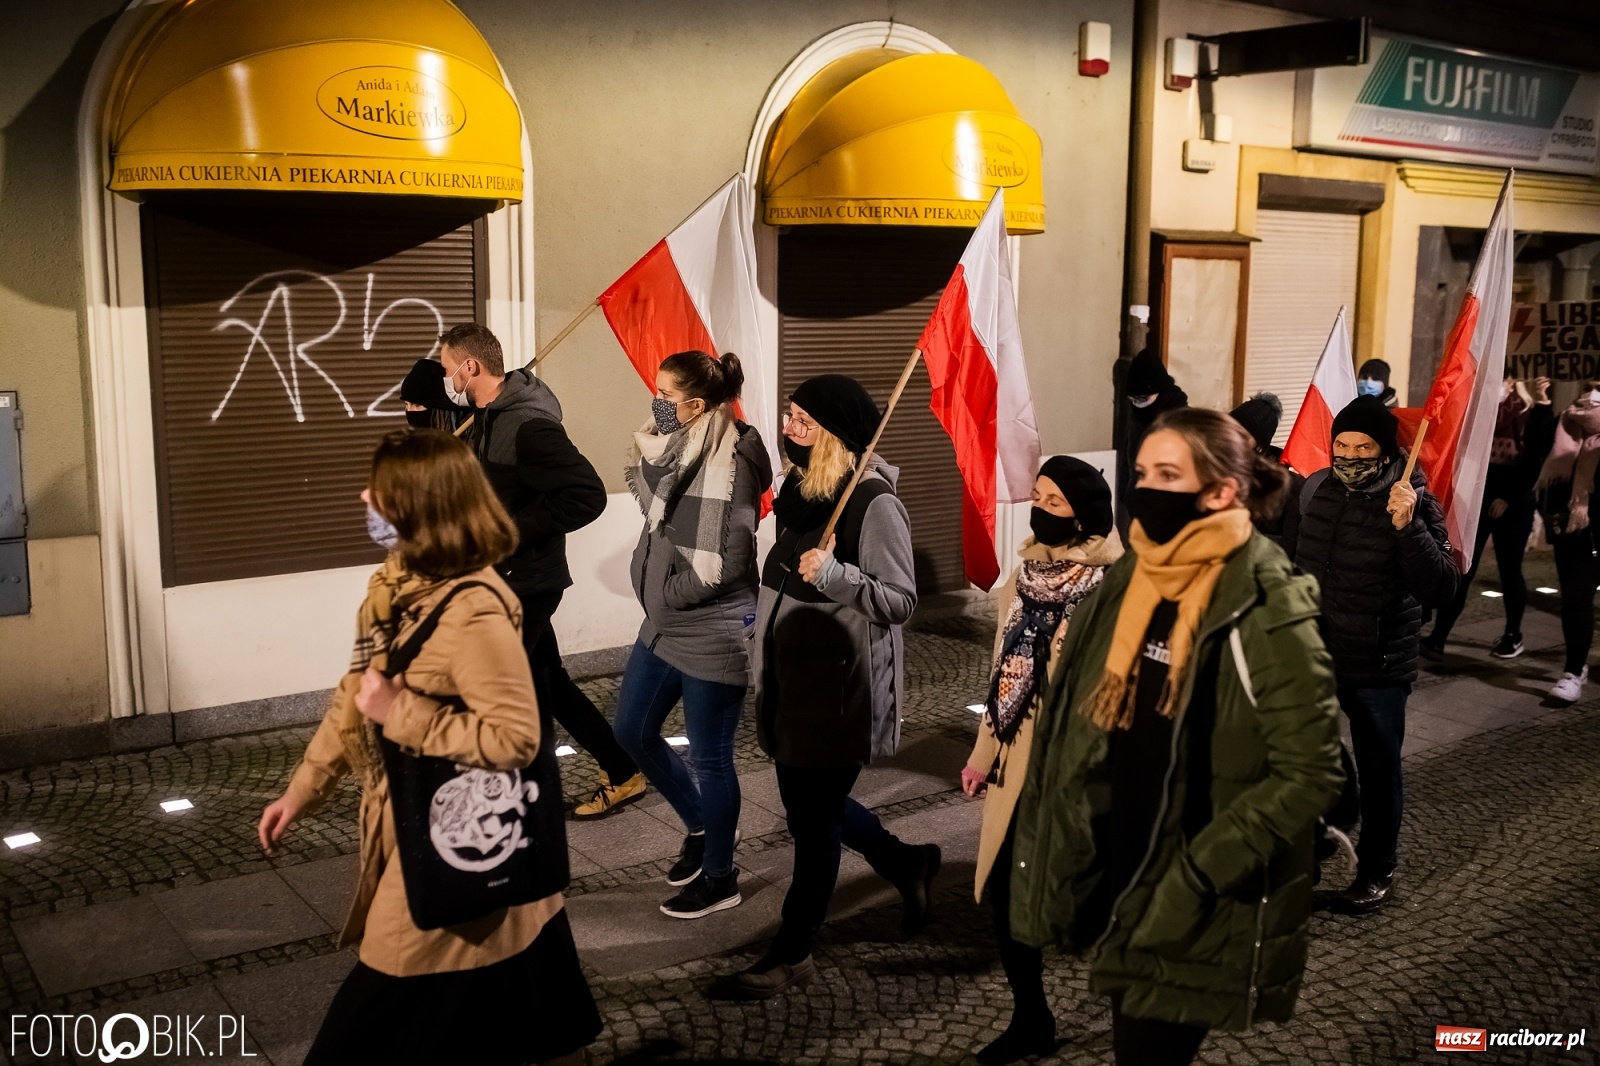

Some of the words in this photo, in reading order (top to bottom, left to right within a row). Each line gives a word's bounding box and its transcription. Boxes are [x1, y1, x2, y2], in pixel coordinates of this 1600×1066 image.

[356, 78, 392, 91] Anida
[395, 80, 400, 91] i
[1404, 56, 1541, 118] FUJIFILM
[336, 96, 455, 127] Markiewka
[117, 166, 175, 183] PIEKARNIA
[179, 165, 282, 182] CUKIERNIA
[289, 167, 396, 185] PIEKARNIA
[400, 170, 483, 189] CUKIERNIA
[769, 206, 832, 218] PIEKARNIA
[836, 206, 919, 219] CUKIERNIA
[923, 207, 985, 221] PIEKARN
[1005, 210, 1039, 223] UKIERNIA
[1541, 303, 1600, 326] LIBE
[1541, 326, 1600, 352] EGA
[1504, 353, 1600, 380] WYPIERD
